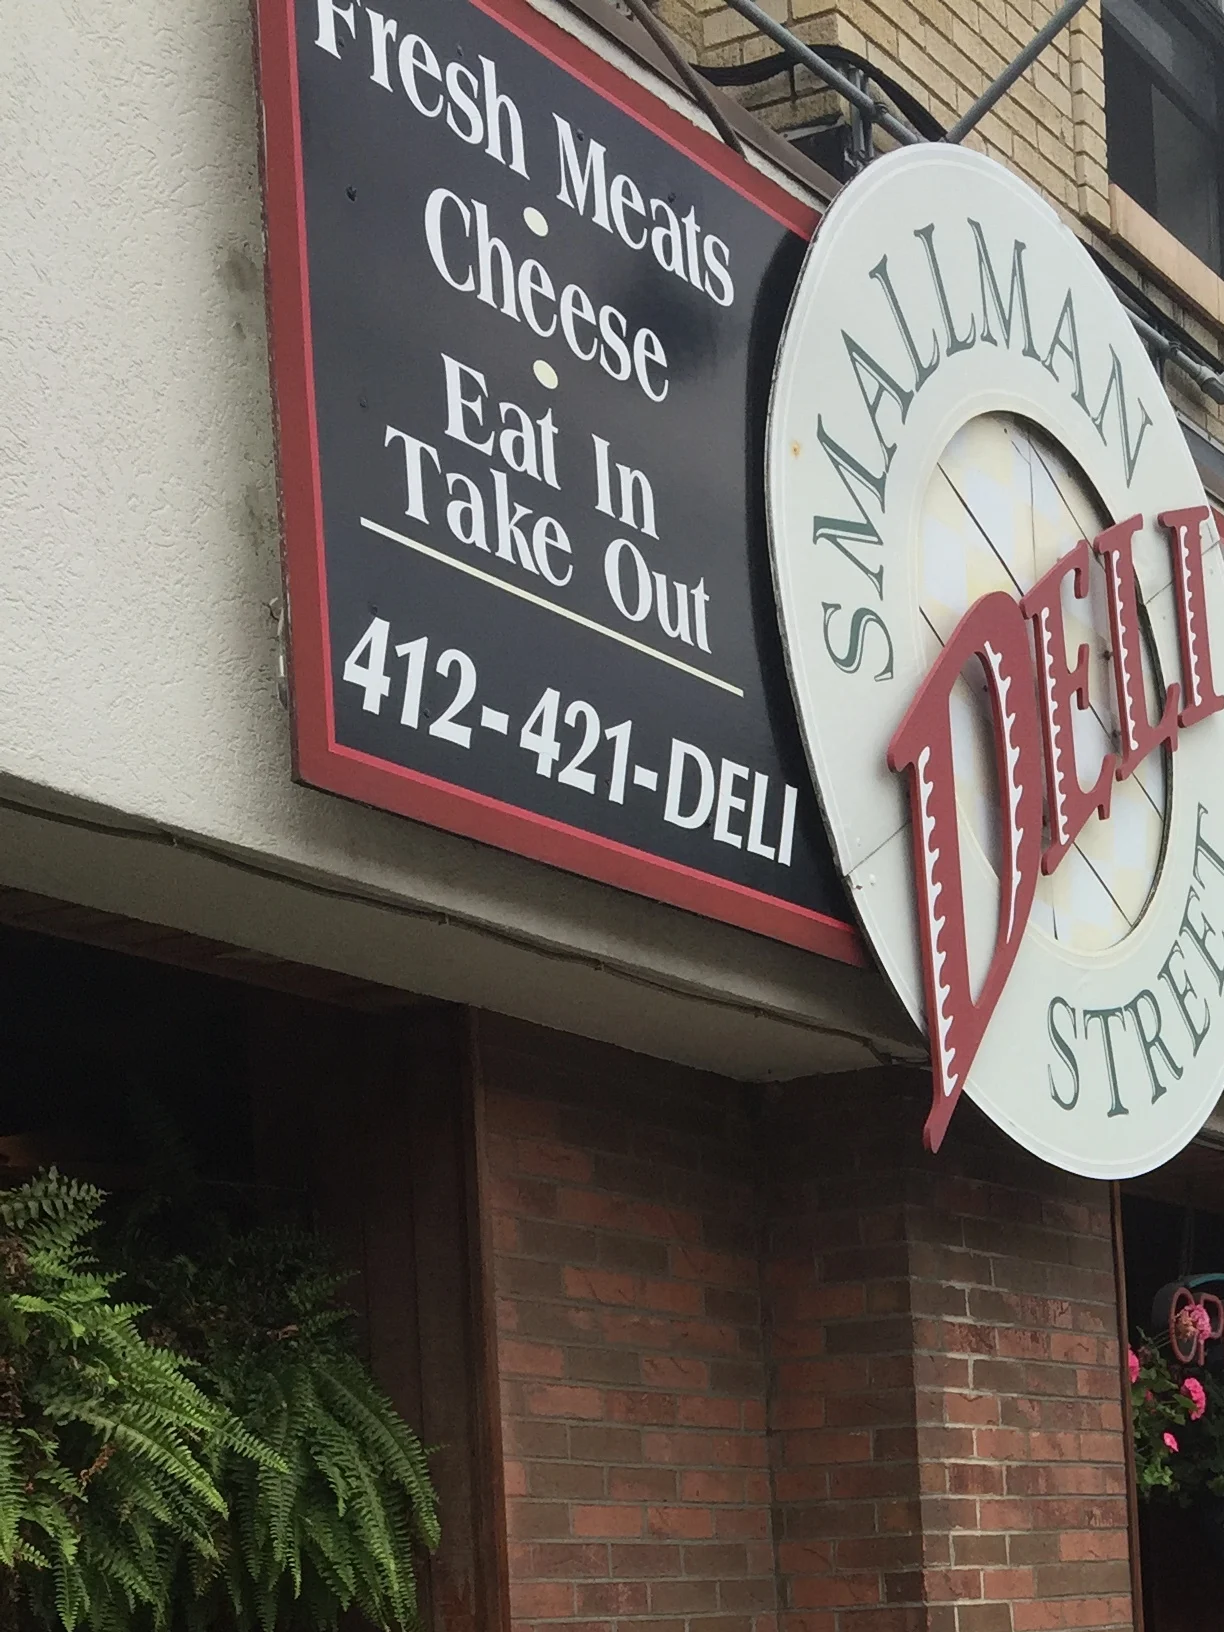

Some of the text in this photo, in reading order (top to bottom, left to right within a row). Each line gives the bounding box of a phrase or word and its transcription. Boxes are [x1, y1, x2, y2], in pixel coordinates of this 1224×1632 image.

[424, 188, 669, 402] Cheese
[552, 112, 735, 307] Meats
[385, 425, 712, 654] Take Out
[441, 353, 659, 539] Eat In
[813, 217, 1153, 682] SMALLMAN
[343, 617, 798, 867] 412-421-DELI
